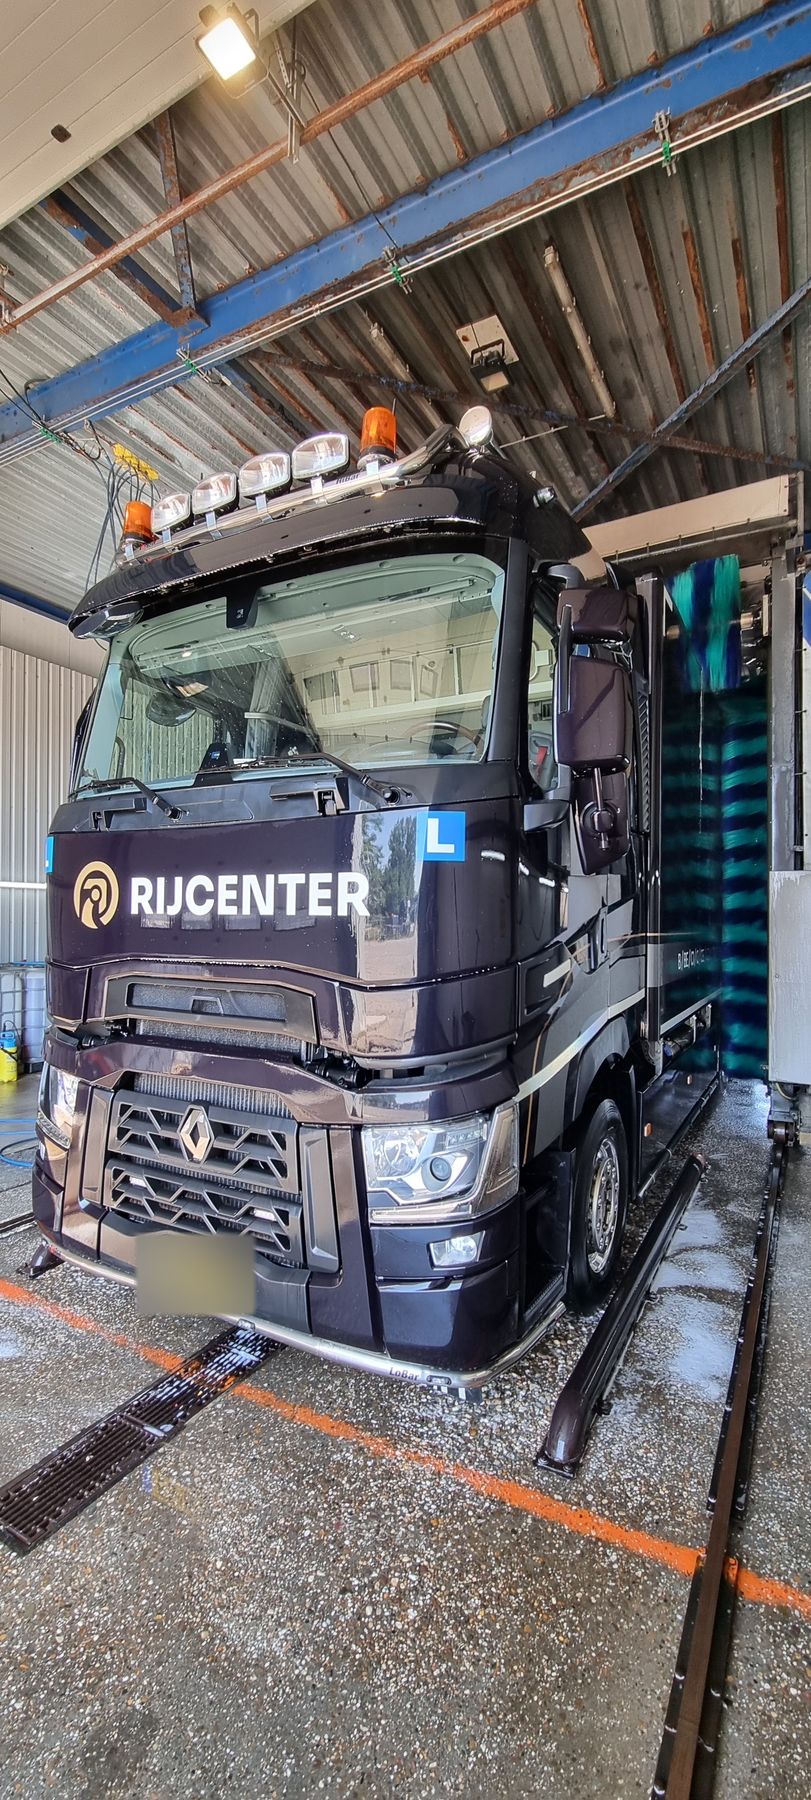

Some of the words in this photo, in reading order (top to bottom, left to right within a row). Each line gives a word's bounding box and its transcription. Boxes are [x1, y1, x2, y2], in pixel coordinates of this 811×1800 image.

[426, 817, 455, 854] L
[130, 871, 371, 917] RIJCENTER
[389, 1366, 419, 1381] LoBar
